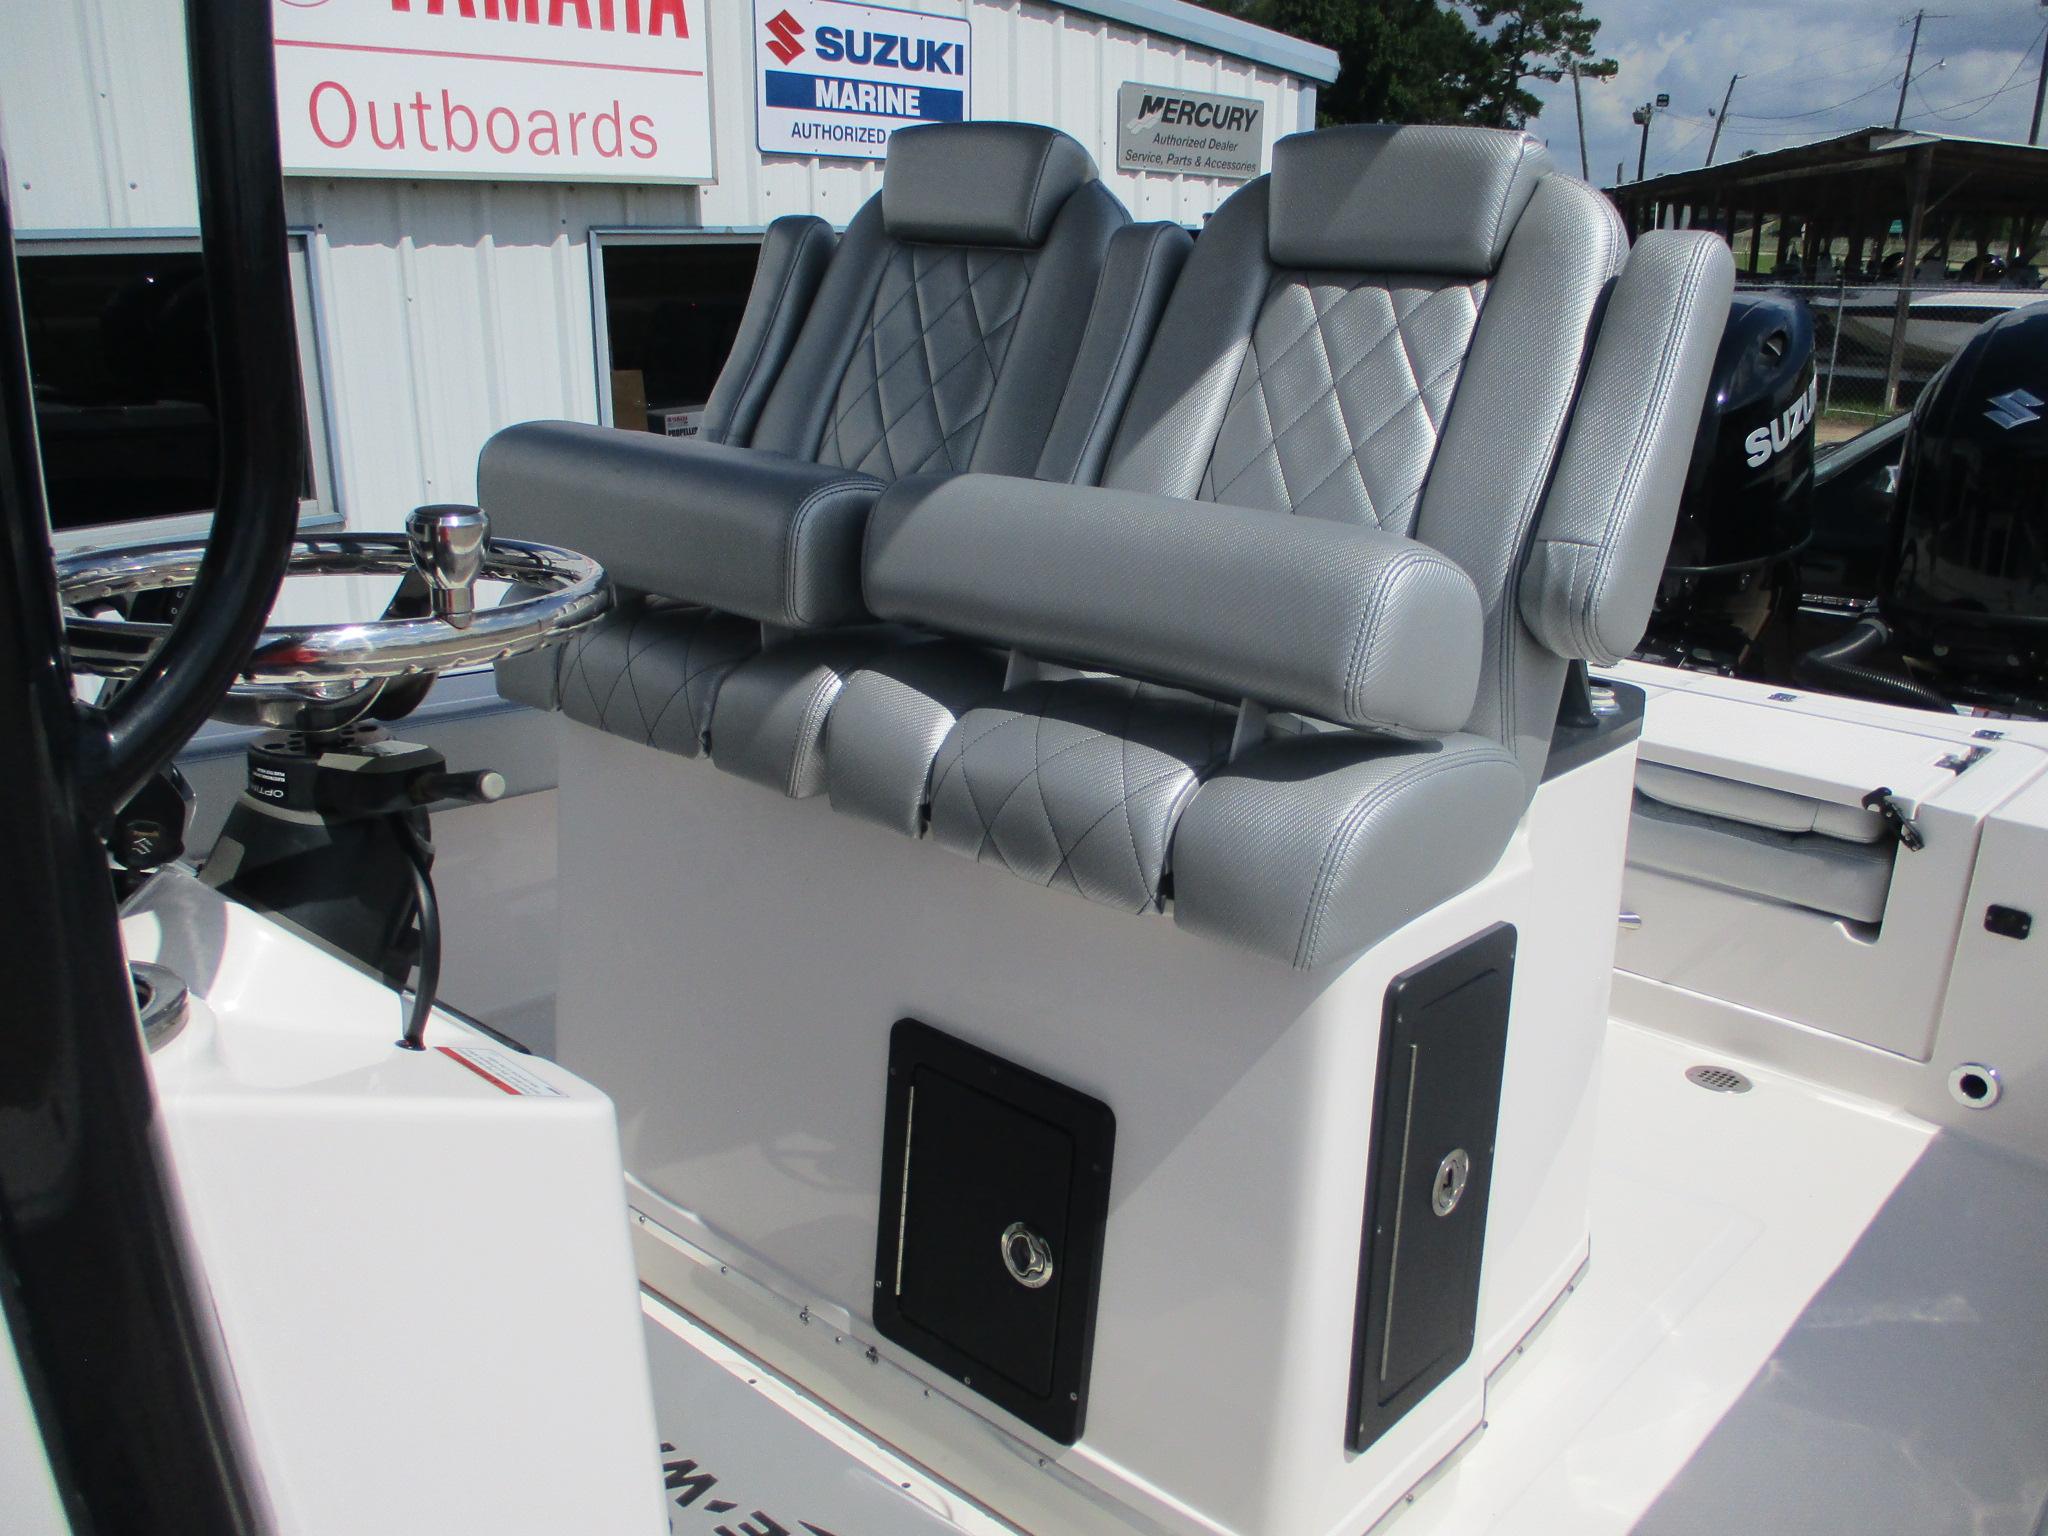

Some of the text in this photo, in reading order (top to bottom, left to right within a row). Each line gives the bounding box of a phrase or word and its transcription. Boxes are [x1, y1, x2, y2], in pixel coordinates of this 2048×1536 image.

[815, 26, 964, 76] SUZUKI
[815, 79, 921, 116] MARINE
[1138, 95, 1259, 132] MERCURY
[309, 80, 658, 160] Outboards
[791, 122, 887, 144] AUTHORIZED
[1125, 149, 1257, 172] Service, Parts & Accessories
[1153, 133, 1239, 151] Authorized Dealer
[1745, 374, 1817, 467] SUZU
